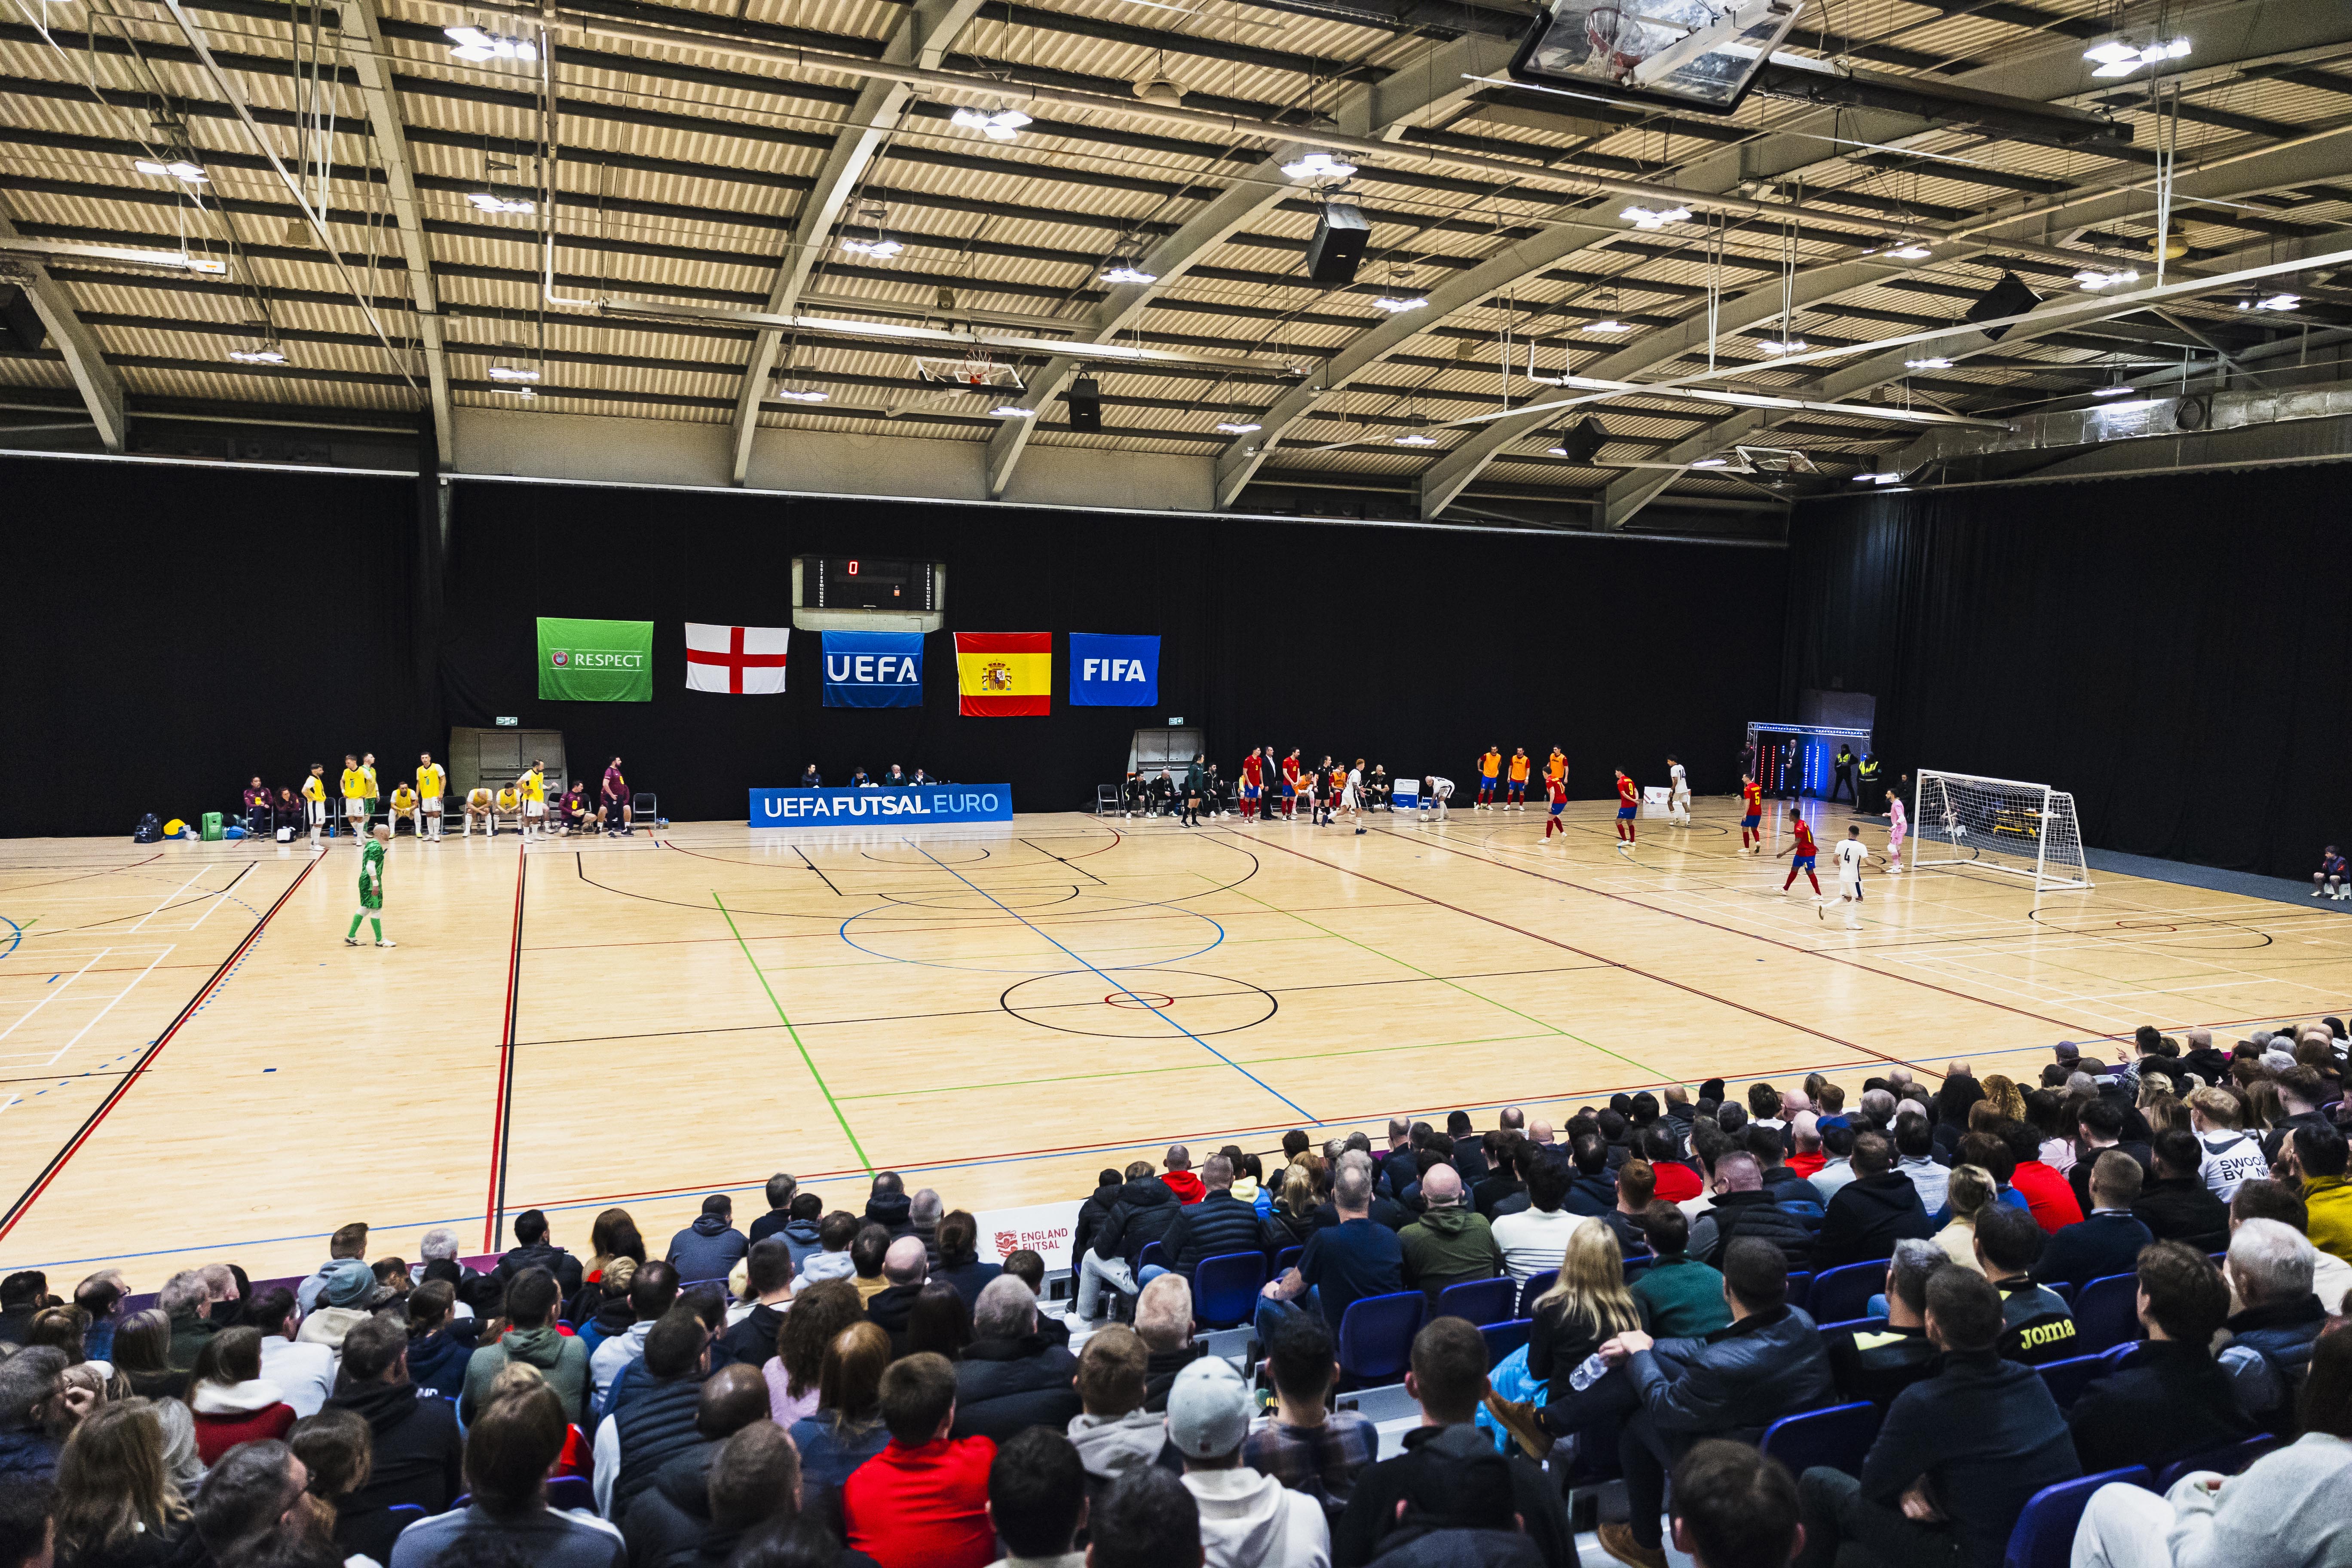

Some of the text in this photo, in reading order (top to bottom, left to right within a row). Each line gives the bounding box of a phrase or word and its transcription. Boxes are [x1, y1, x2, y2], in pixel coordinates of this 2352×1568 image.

[848, 561, 858, 575] 0
[575, 654, 643, 667] RESPECT
[827, 655, 918, 682] UEFA
[1084, 659, 1146, 682] FIFA
[1679, 769, 1686, 780] 14
[1628, 783, 1633, 795] 9
[934, 794, 998, 813] EURO
[1755, 792, 1760, 805] 5
[1844, 848, 1850, 864] 4
[2220, 1156, 2266, 1170] SWOOS
[2223, 1169, 2243, 1181] BY
[1021, 1228, 1068, 1242] ENGLAND
